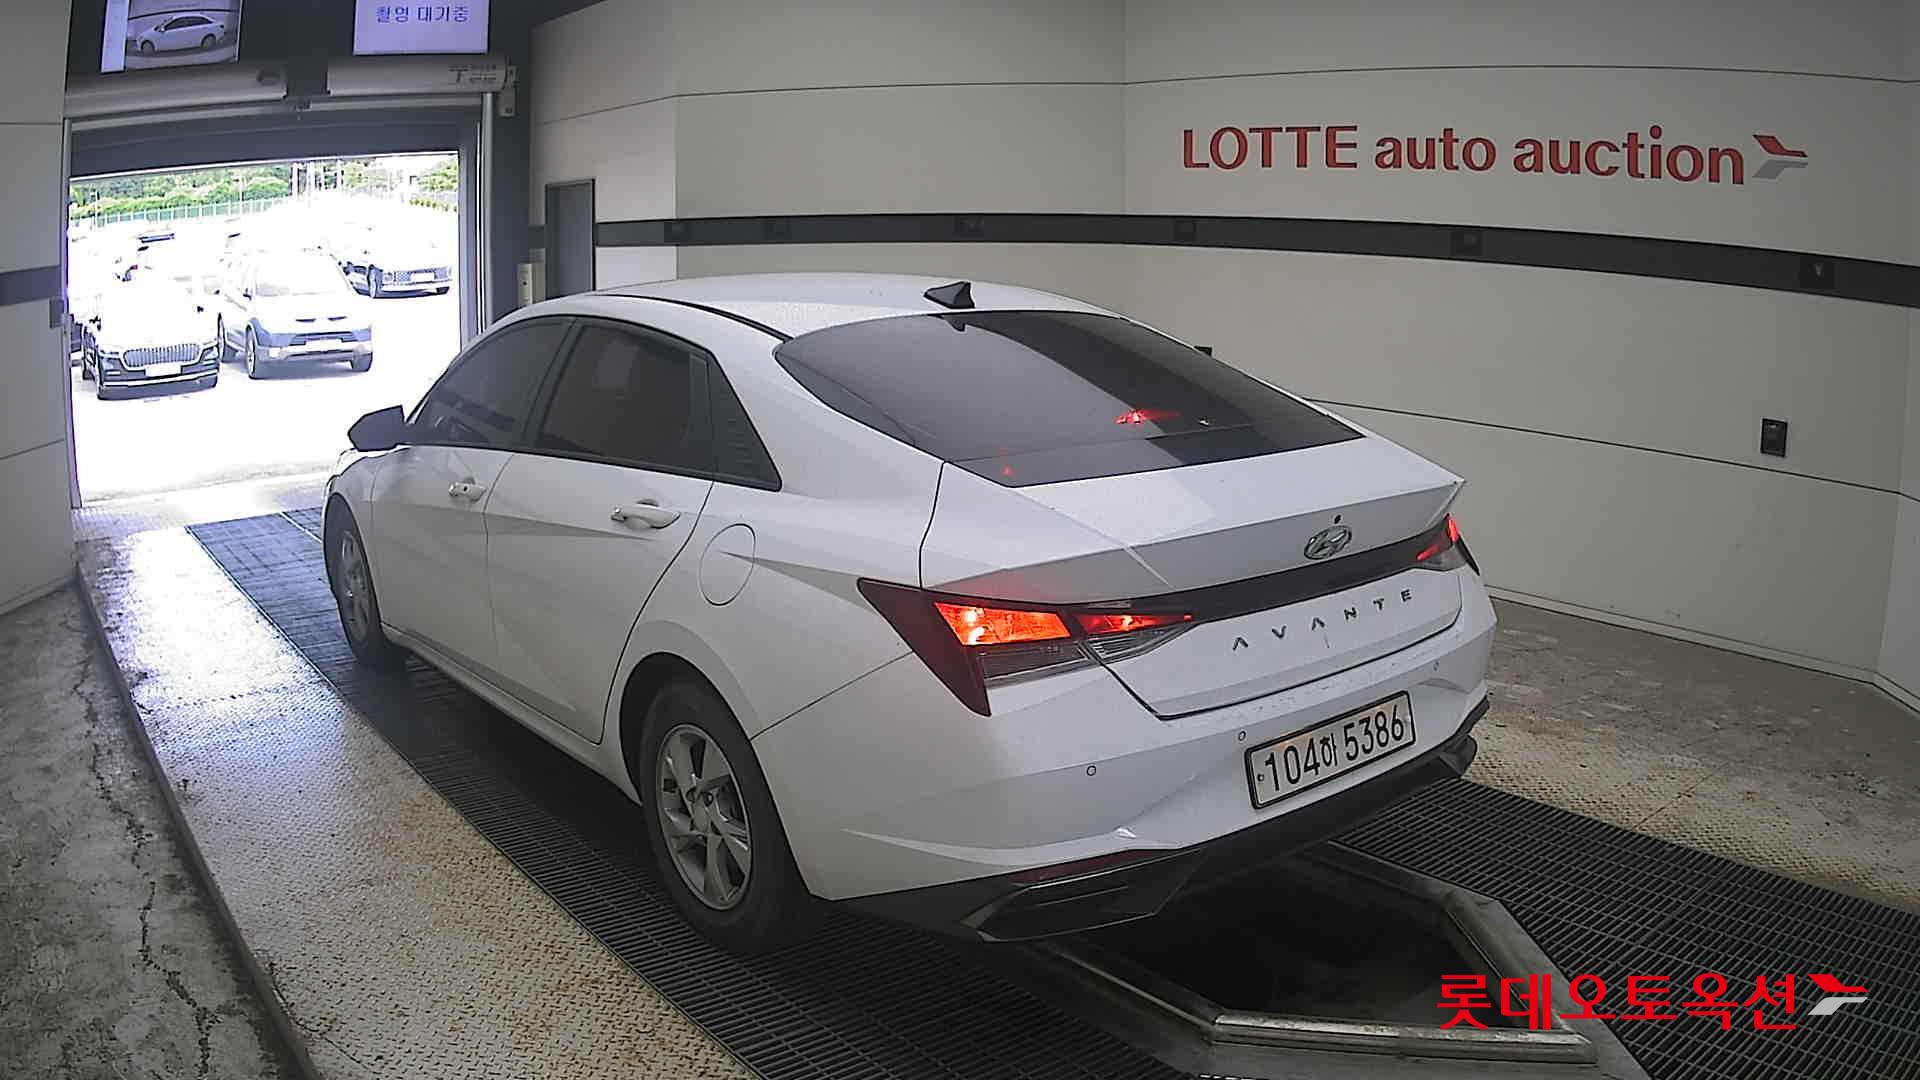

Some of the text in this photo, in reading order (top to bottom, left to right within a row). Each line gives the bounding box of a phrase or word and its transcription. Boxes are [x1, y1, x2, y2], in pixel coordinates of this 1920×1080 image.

[417, 5, 469, 23] 대기중
[1183, 124, 1744, 185] LOTTE auto auction
[1231, 589, 1413, 651] AVANTE
